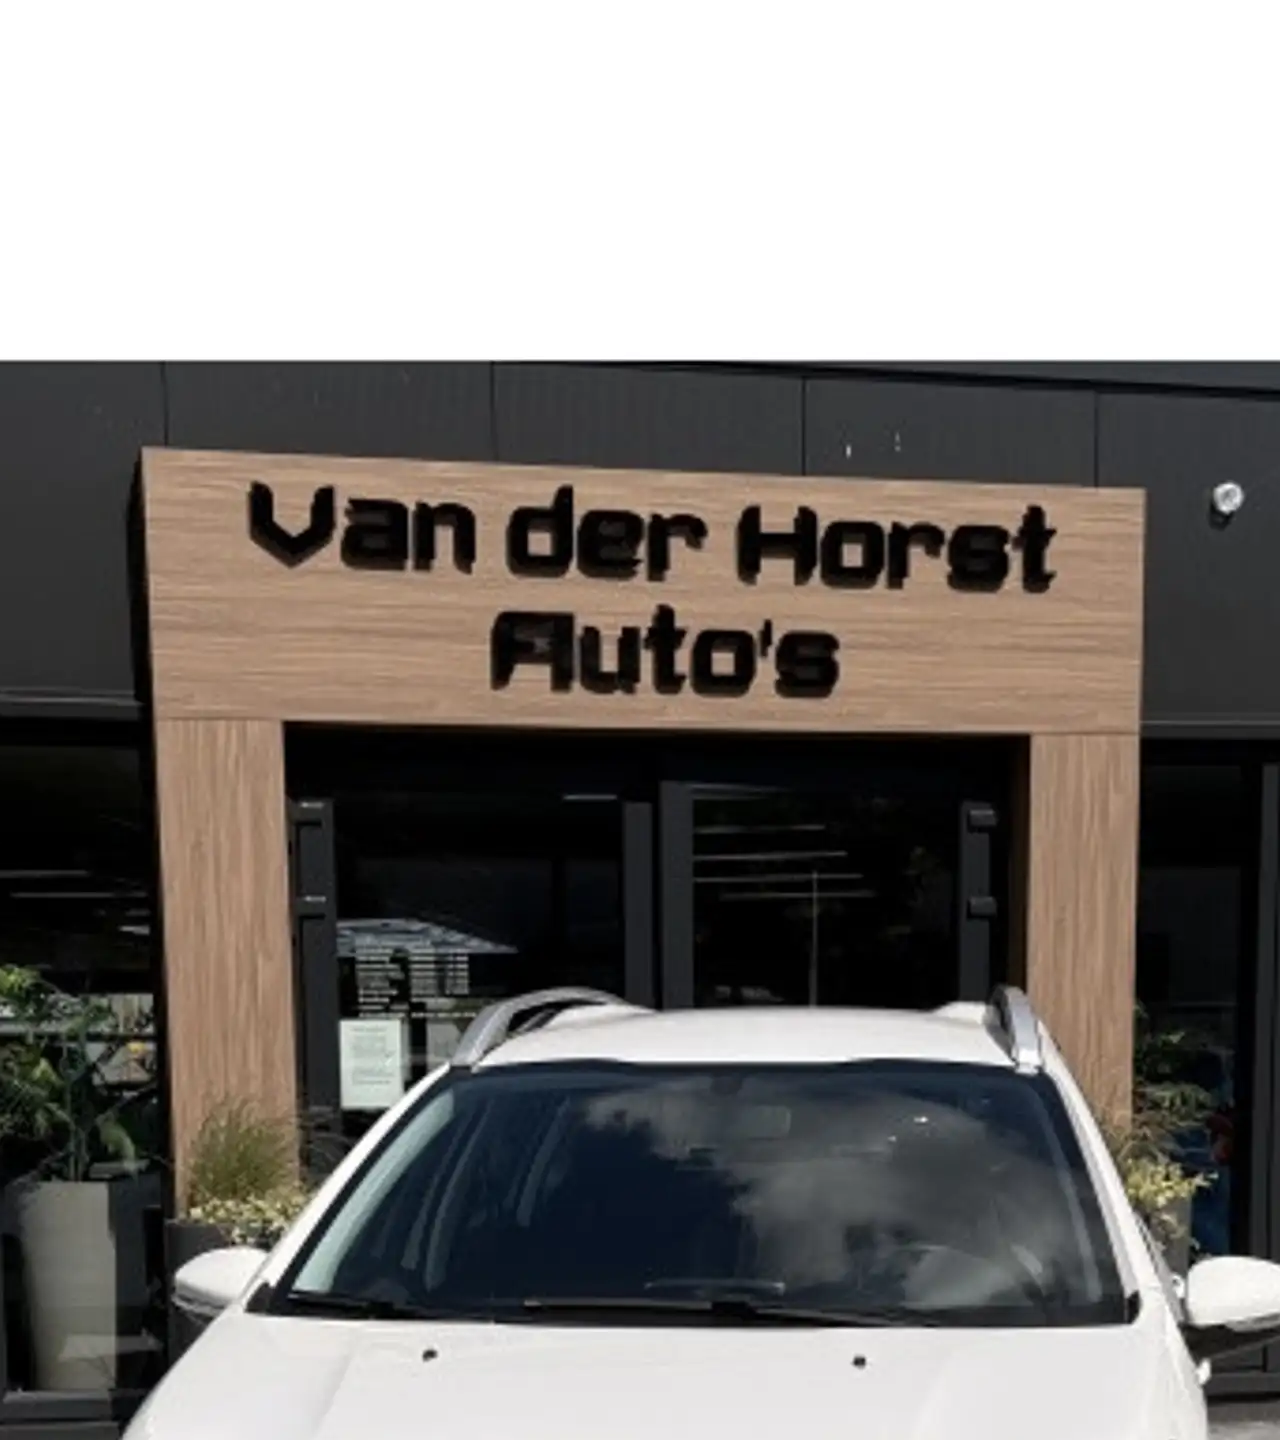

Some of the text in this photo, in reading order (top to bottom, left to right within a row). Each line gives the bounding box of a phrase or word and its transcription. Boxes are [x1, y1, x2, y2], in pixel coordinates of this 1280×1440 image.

[248, 481, 1056, 593] Van der Horst
[490, 605, 839, 698] Auto's
